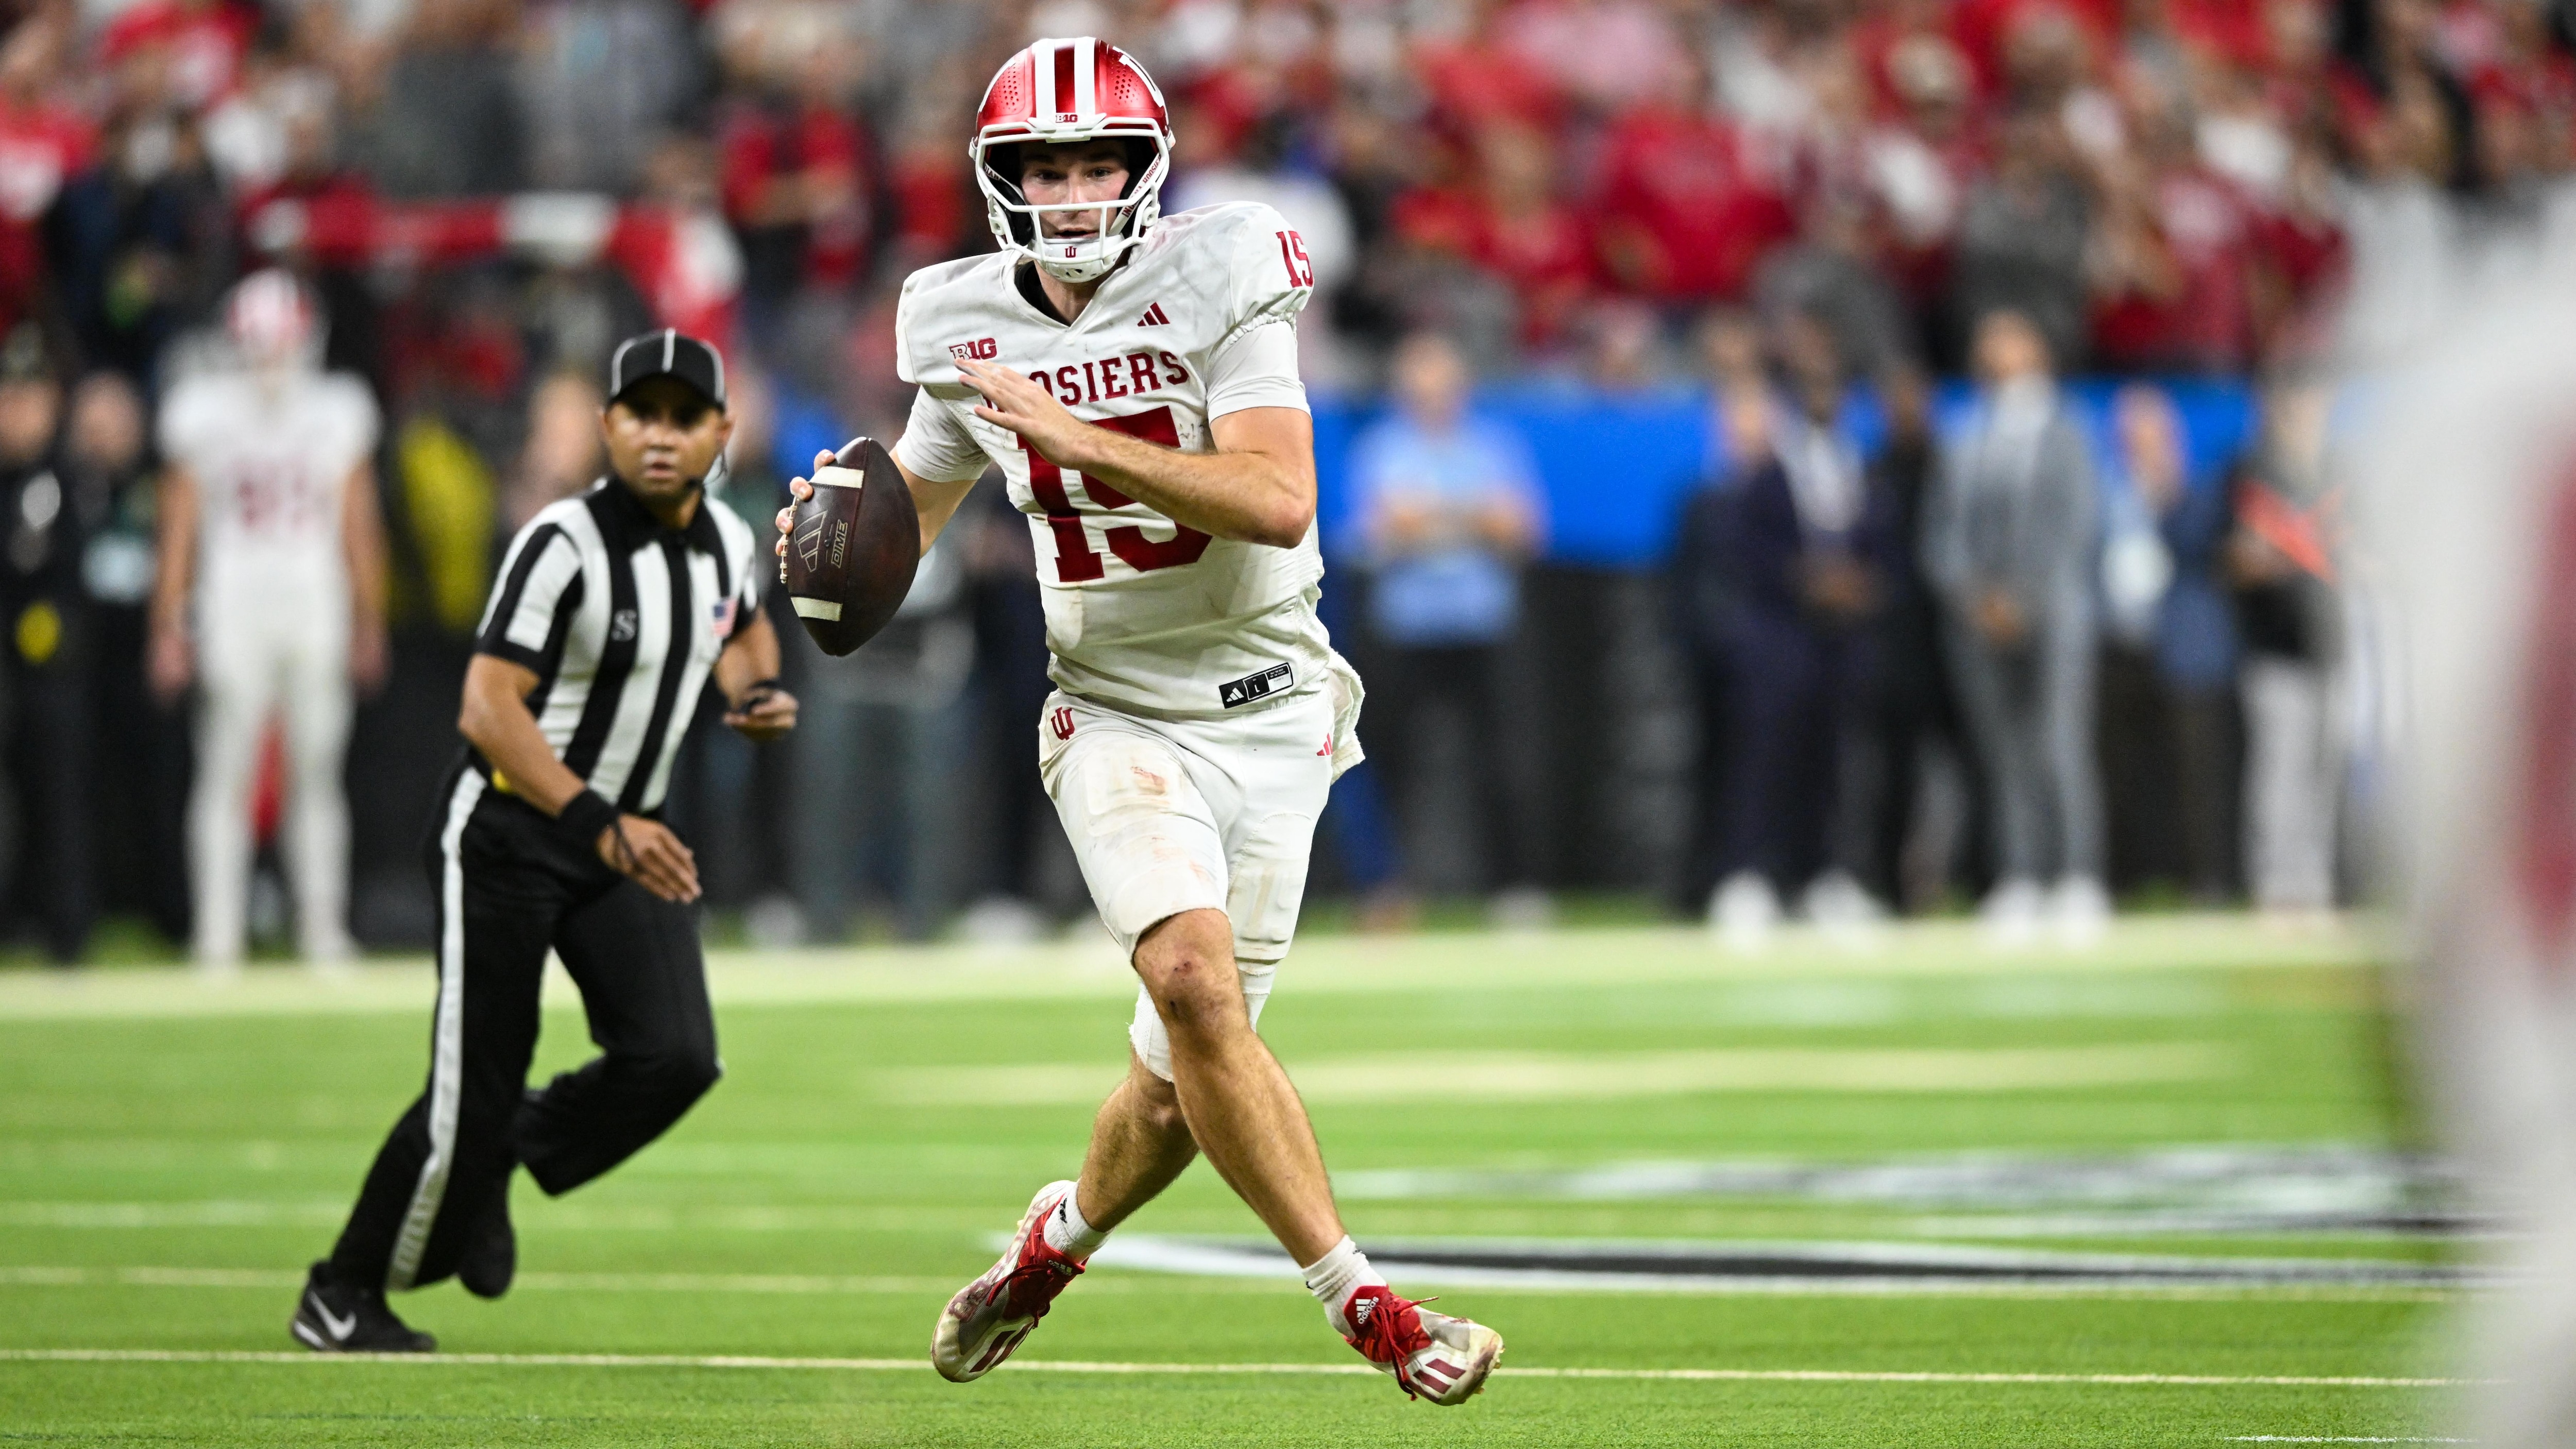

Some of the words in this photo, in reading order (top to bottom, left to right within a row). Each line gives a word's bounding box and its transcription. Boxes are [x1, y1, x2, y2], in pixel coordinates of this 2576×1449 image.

[1276, 230, 1313, 288] 15
[981, 351, 1189, 412] OSIERS
[1016, 405, 1213, 583] 15
[831, 519, 848, 568] DIME
[611, 609, 637, 642] S
[1254, 684, 1260, 693] L
[1359, 1297, 1379, 1324] adidas
